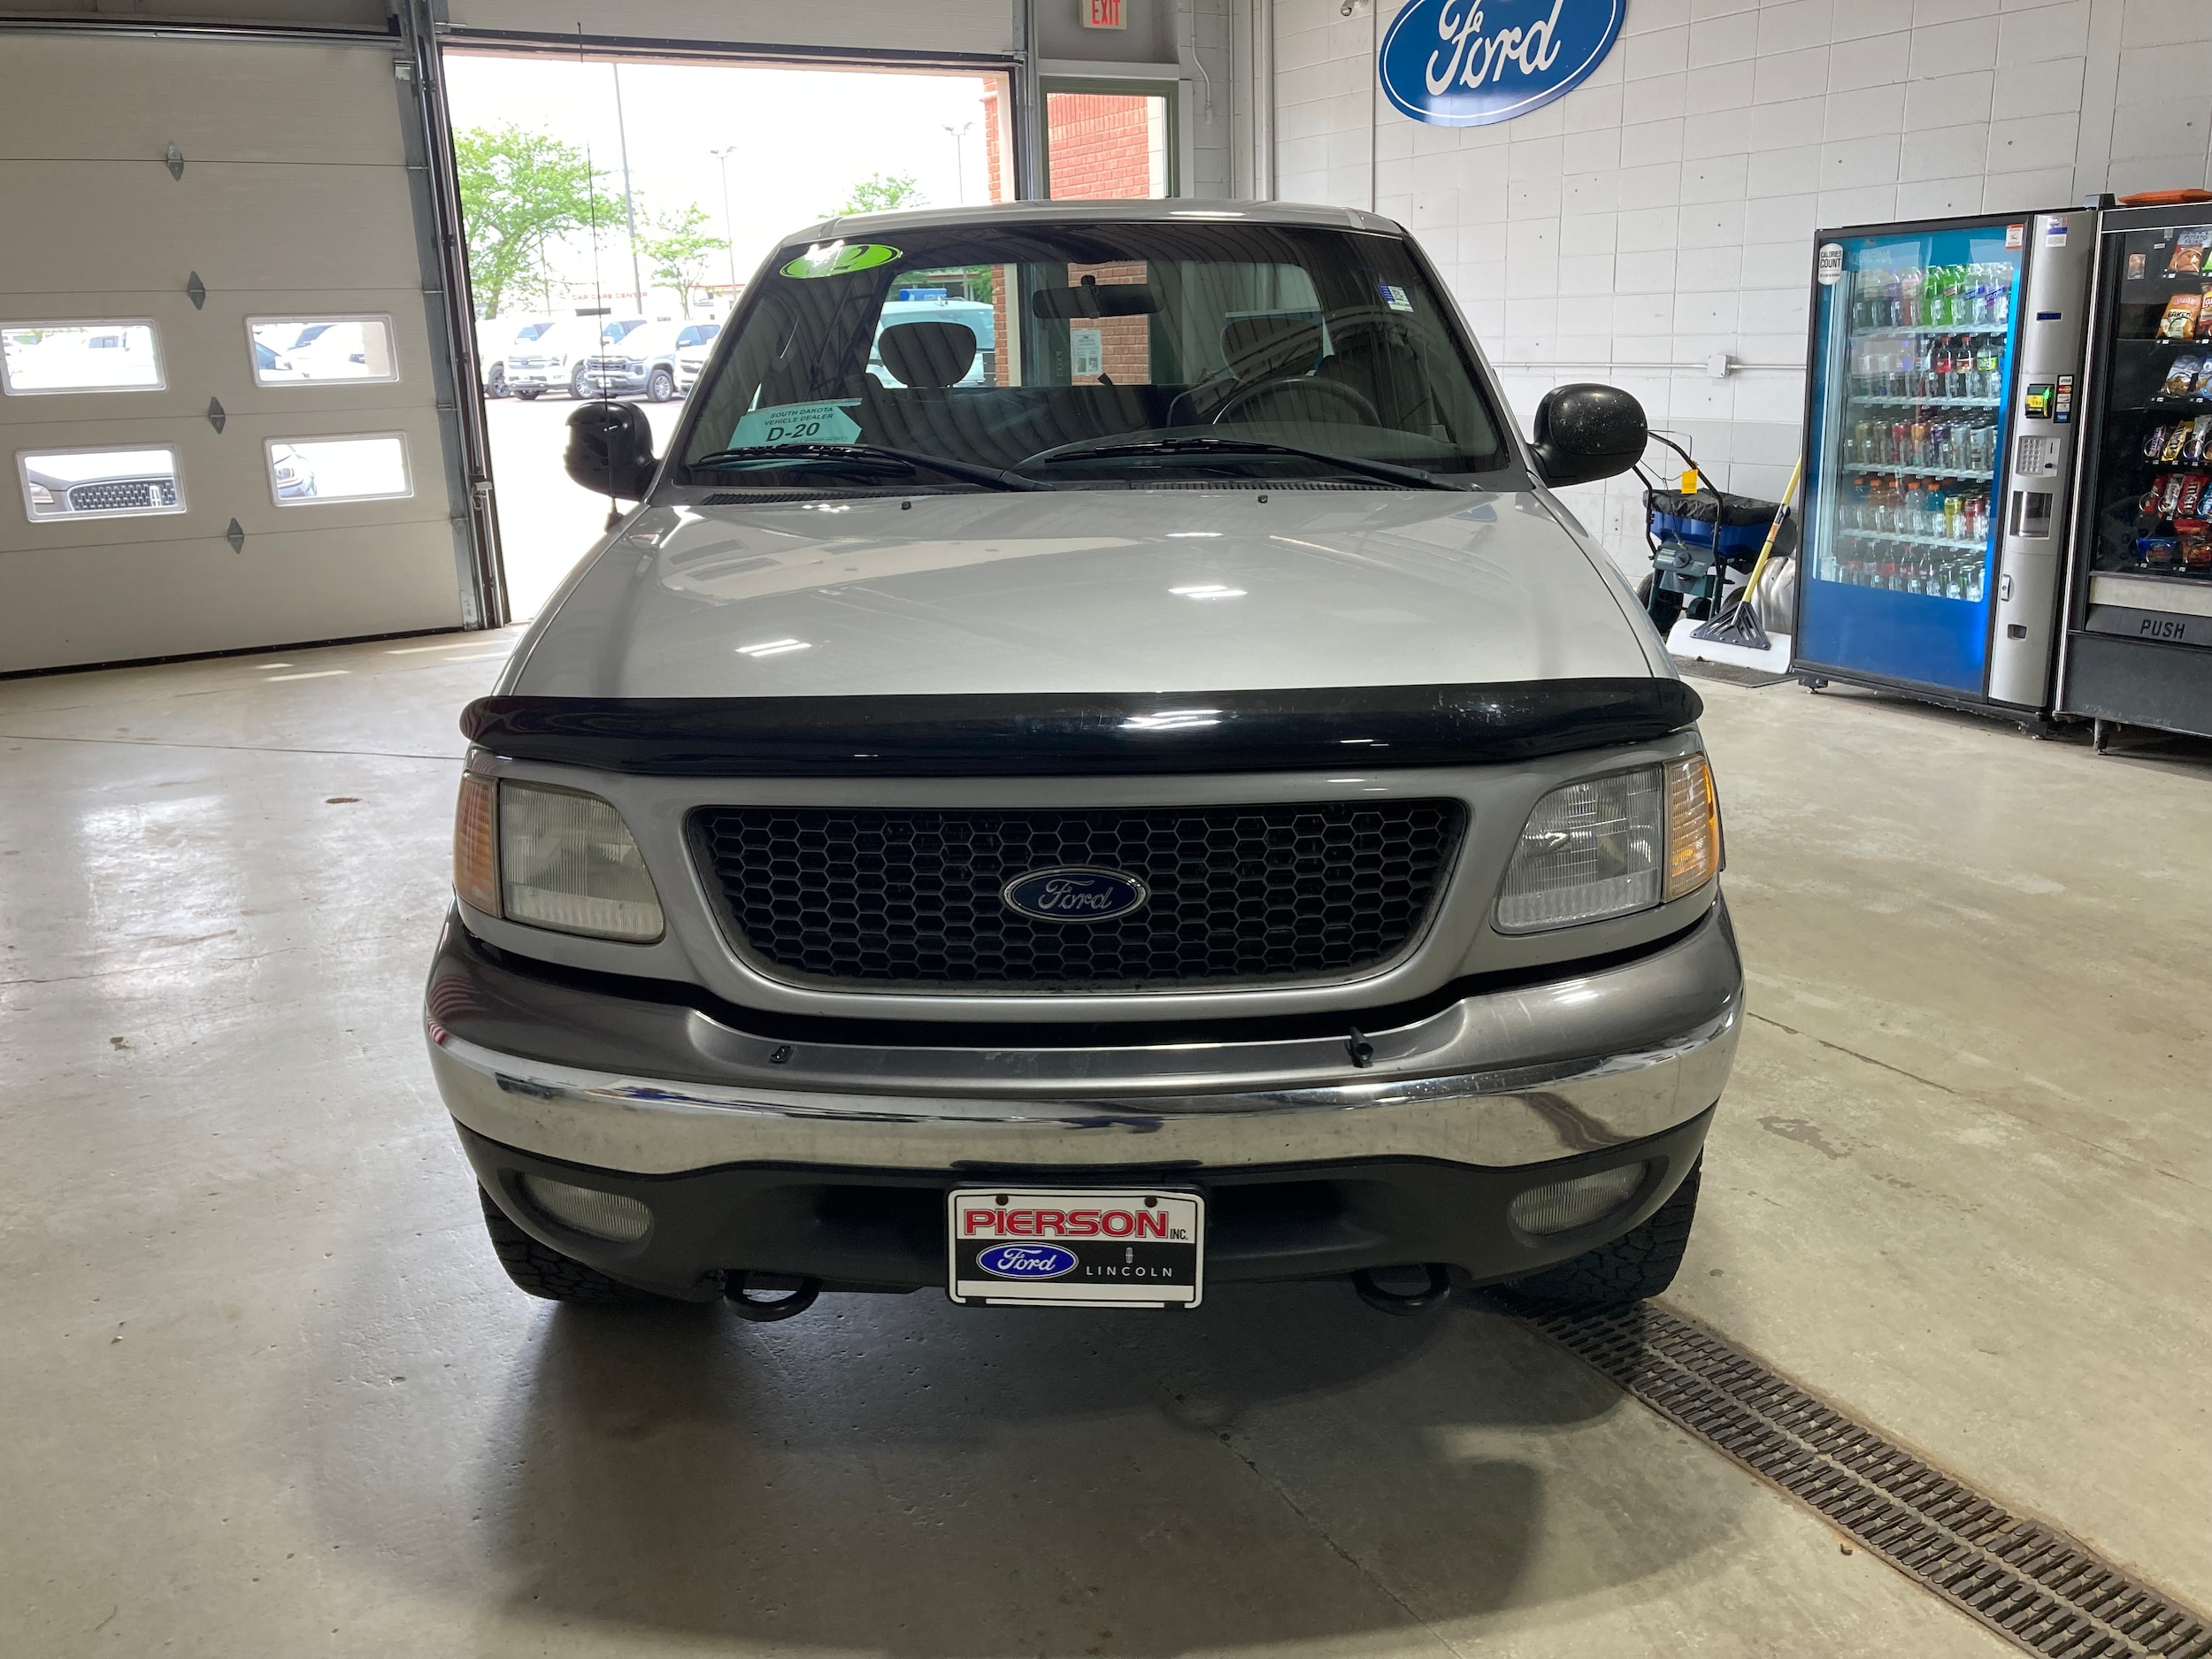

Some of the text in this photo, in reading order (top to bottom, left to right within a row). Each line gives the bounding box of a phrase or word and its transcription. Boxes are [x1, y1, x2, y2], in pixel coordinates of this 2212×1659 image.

[1092, 0, 1120, 26] EXIT
[1425, 0, 1564, 96] Ford
[1819, 257, 1841, 268] COUNT
[764, 413, 833, 426] VEHICLE DEALER
[770, 406, 833, 419] SOUTH DAKOTA
[766, 422, 820, 442] D-20
[2140, 618, 2185, 640] PUSH
[1038, 879, 1114, 910] Ford
[964, 1209, 1189, 1240] PIERSON INC.
[997, 1248, 1056, 1271] Ford
[1087, 1265, 1172, 1278] LINCOLN
